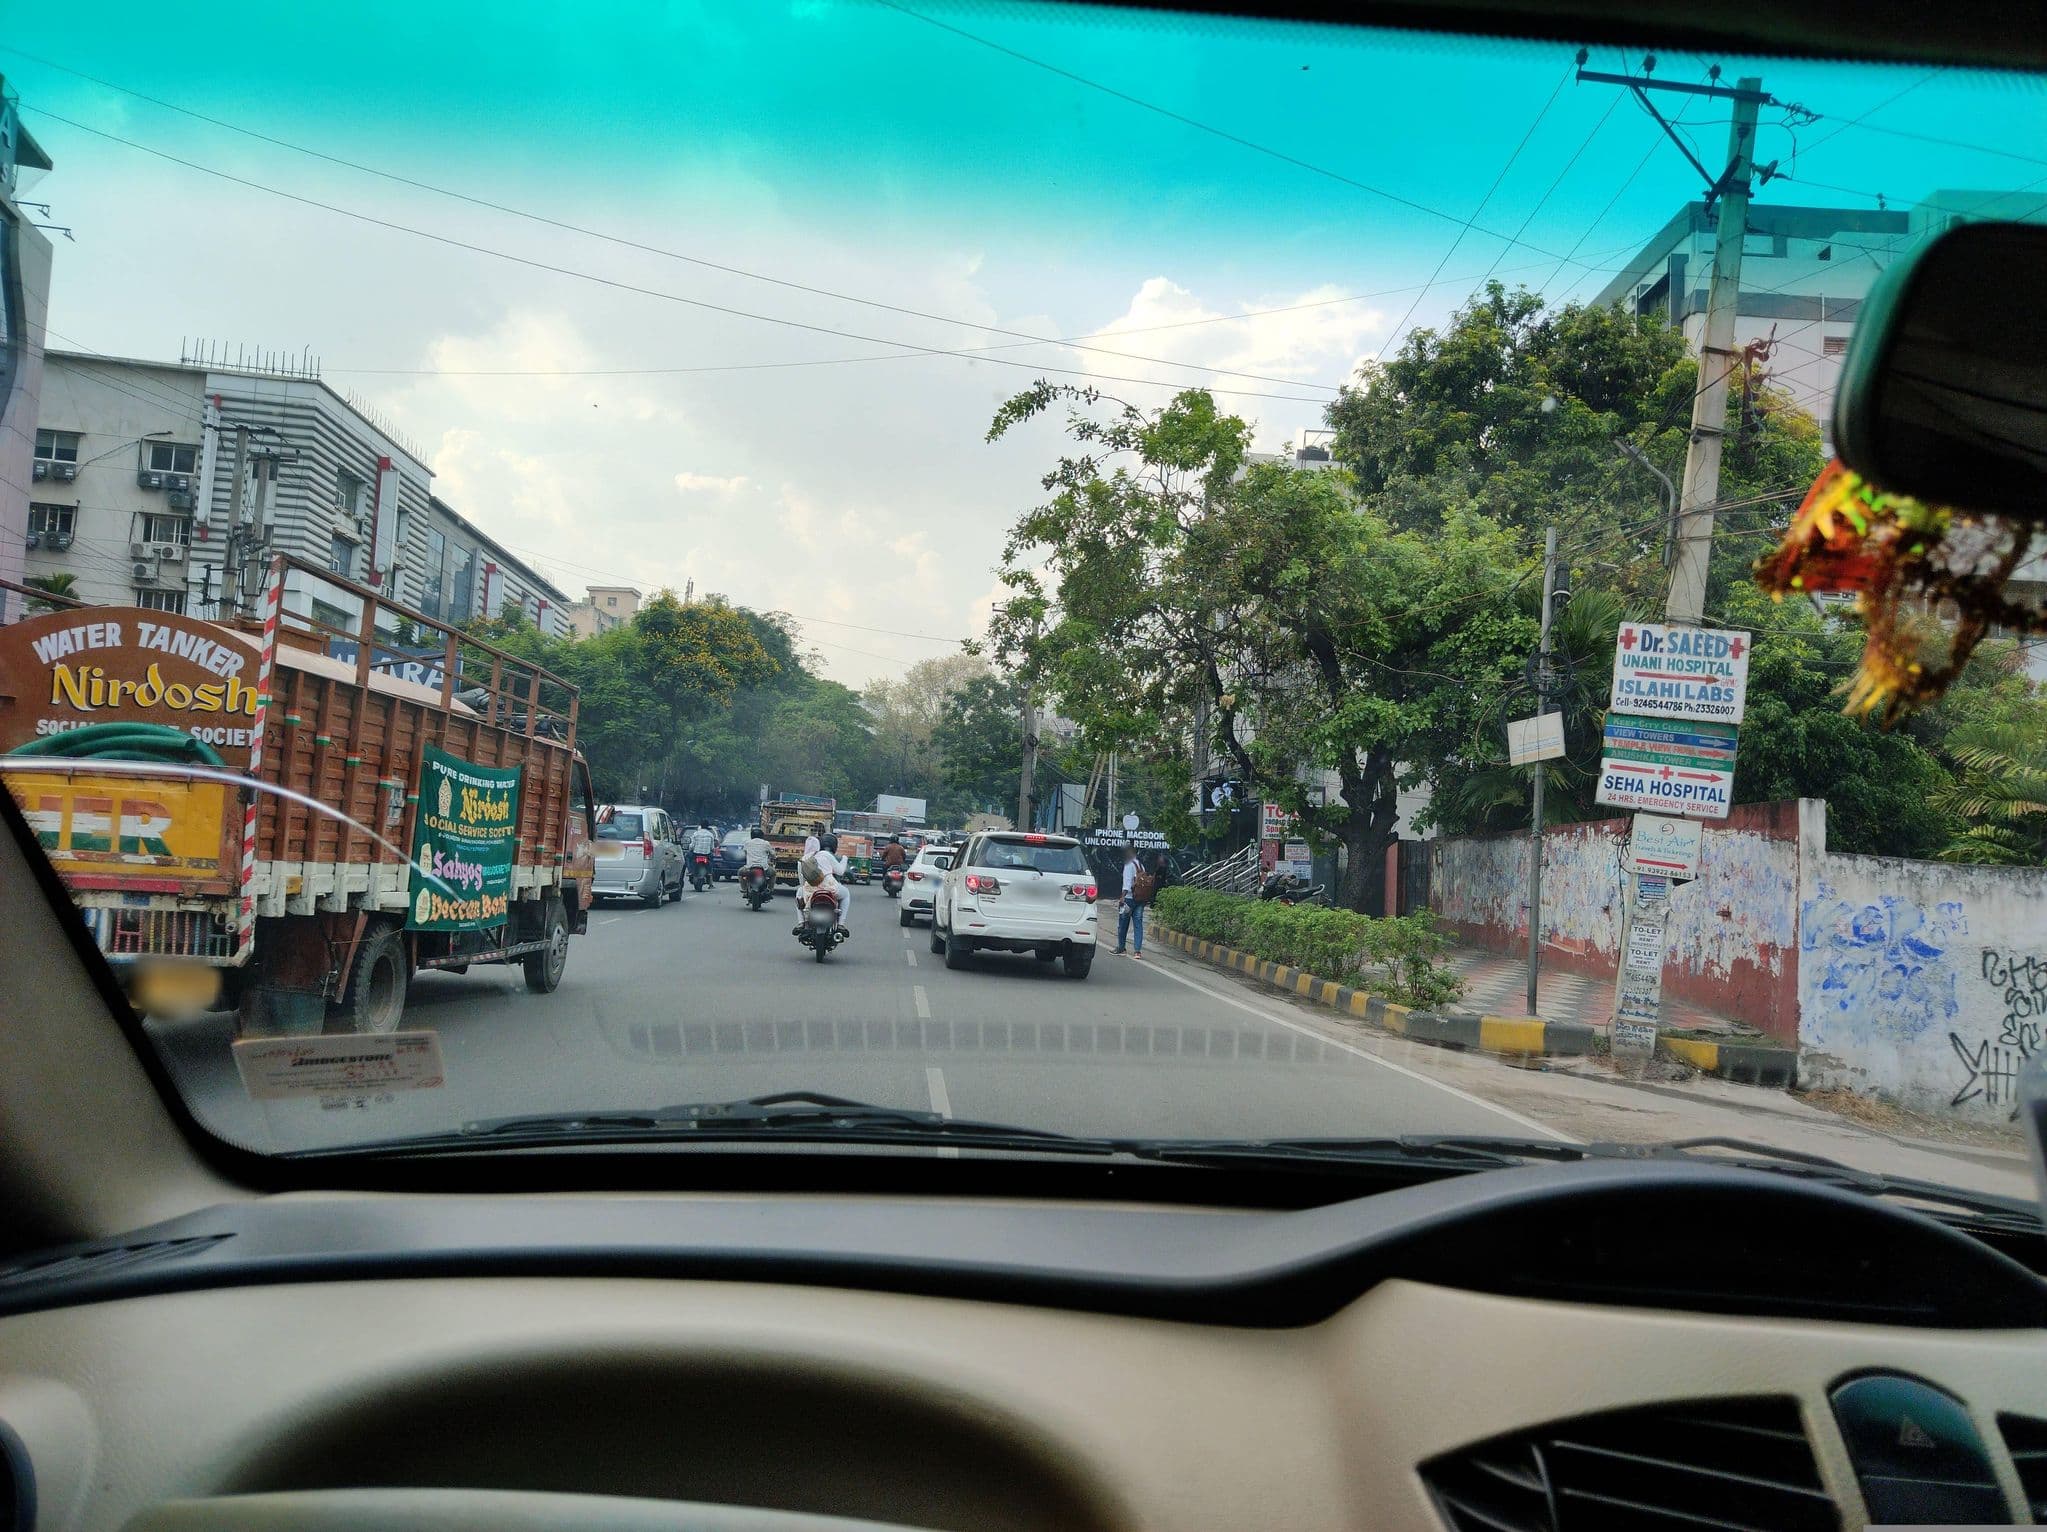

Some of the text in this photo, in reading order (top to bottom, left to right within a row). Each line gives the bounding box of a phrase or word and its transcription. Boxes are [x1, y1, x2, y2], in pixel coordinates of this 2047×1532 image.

[32, 622, 245, 679] WATER TANKER
[1640, 629, 1729, 658] Dr. SAEED
[1622, 654, 1733, 676] UNANI HOSPITAL
[52, 662, 258, 715] Nirdosh
[1619, 679, 1734, 702] ISLAHI LABS
[190, 726, 255, 748] SOCIET
[1613, 728, 1675, 742] VIEW TOWERS
[1611, 751, 1692, 766] ANUSHKA TOWER
[432, 760, 458, 780] PURE
[458, 772, 495, 789] DRINKING
[1604, 775, 1726, 803] SEHA HOSPITAL
[1607, 793, 1719, 814] 24 HRS. EMERGENCY SERVICE
[458, 825, 487, 839] SERVICE
[1085, 837, 1130, 847] UNLOCKING
[1095, 829, 1165, 840] IPHONE MACBOOK
[432, 851, 482, 891] Sahyog
[1633, 926, 1662, 935] TO-LET
[1630, 949, 1659, 957] TO-LET
